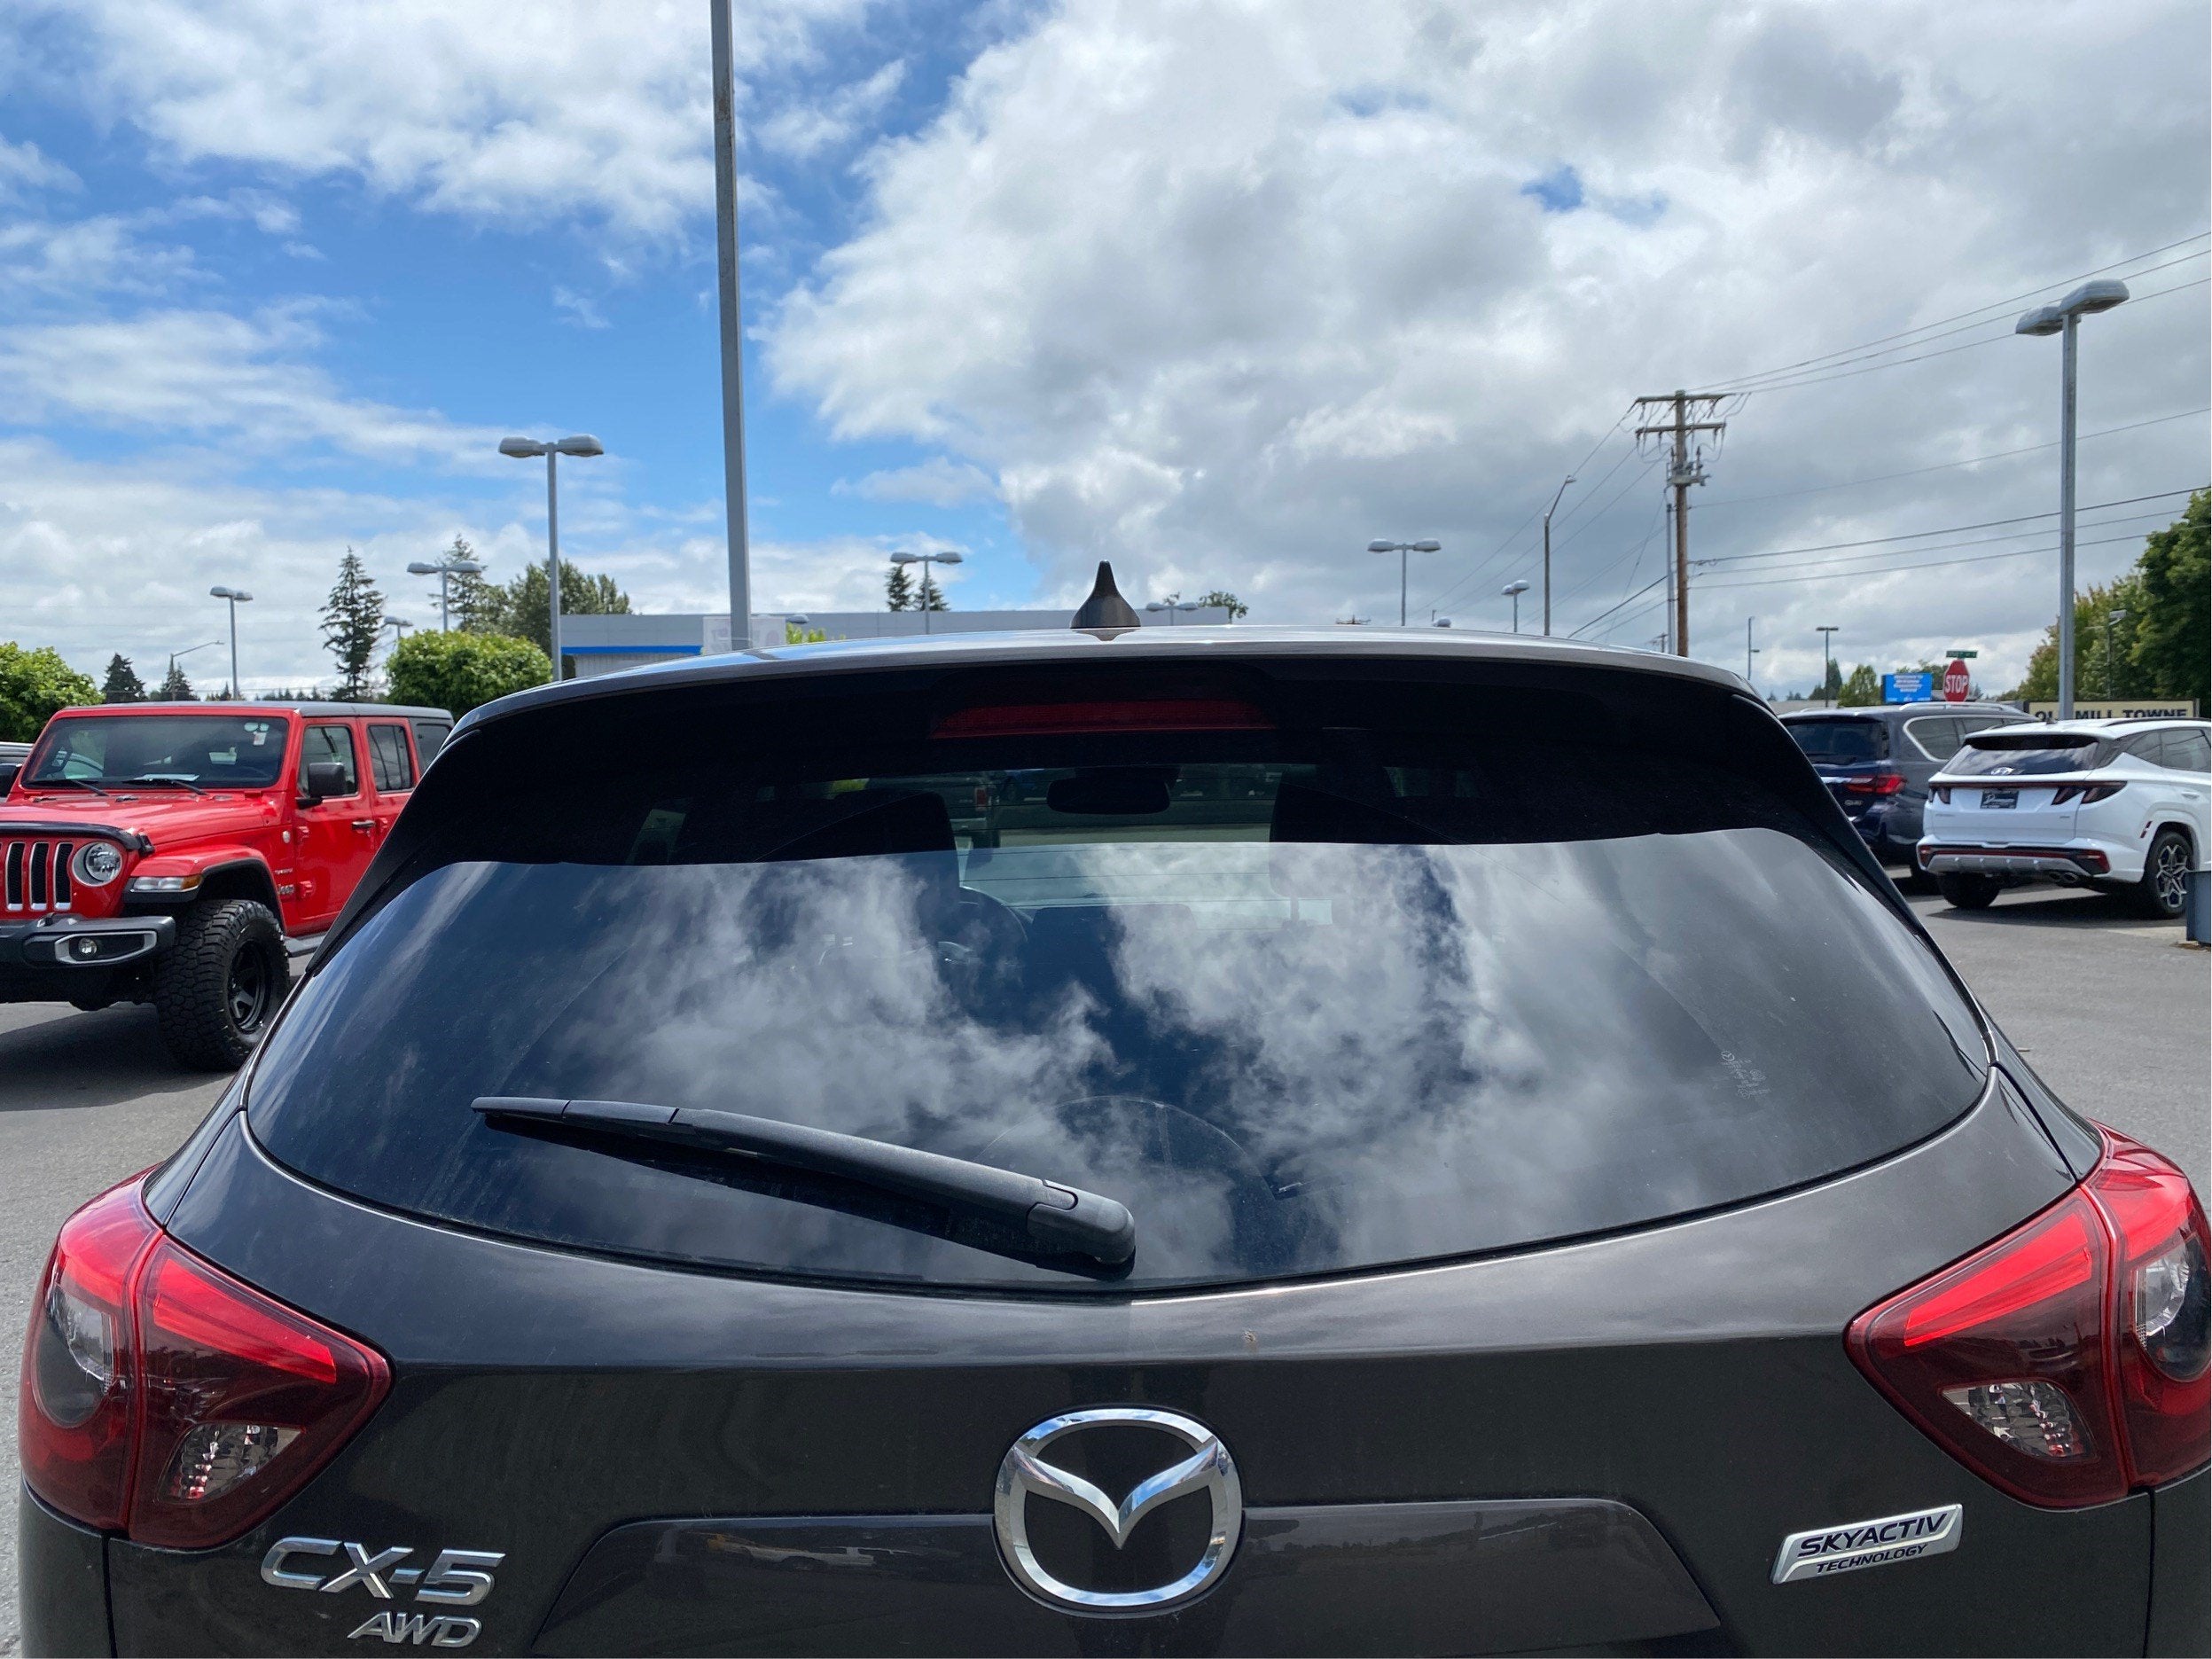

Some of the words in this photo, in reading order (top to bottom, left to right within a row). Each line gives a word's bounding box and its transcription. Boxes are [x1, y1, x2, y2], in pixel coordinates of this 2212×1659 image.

[1944, 675, 1968, 693] STOP
[2075, 710, 2113, 719] MILL
[2122, 709, 2187, 718] TOWNE
[1797, 1513, 1947, 1558] SKYACTIV
[260, 1537, 506, 1606] CX-5
[1816, 1544, 1928, 1573] TECHNOLOGY
[347, 1610, 482, 1648] AWD
